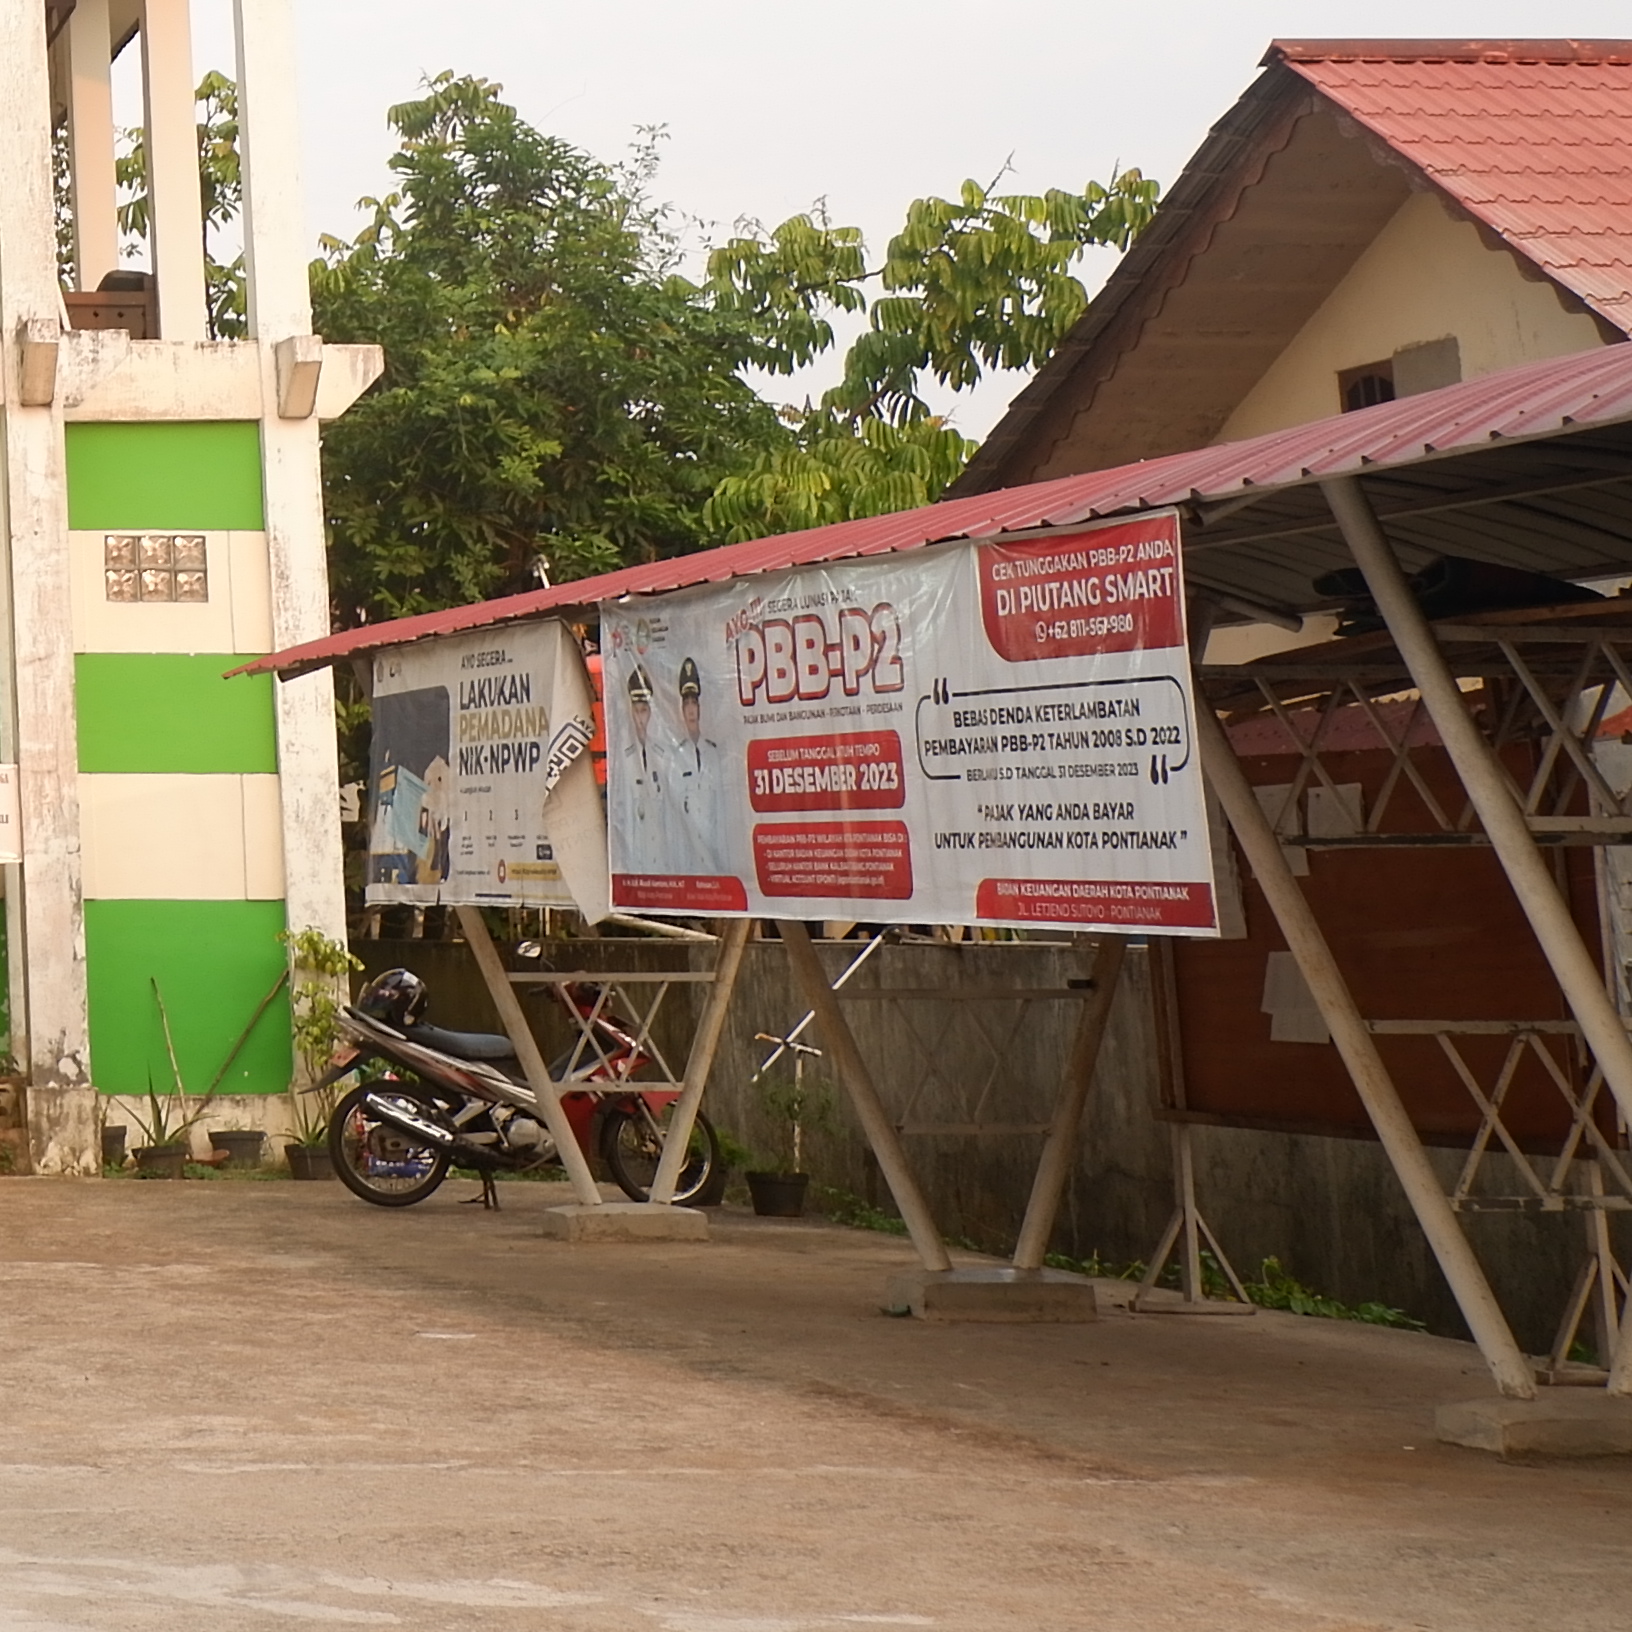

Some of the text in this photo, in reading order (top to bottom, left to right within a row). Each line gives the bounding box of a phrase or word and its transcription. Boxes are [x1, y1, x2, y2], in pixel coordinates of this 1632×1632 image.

[992, 539, 1174, 581] CEK TUNGGAKAN PBB-P2 ANDA
[997, 567, 1174, 616] DI PIUTANG SMART
[767, 598, 798, 615] SEGERA
[1048, 622, 1068, 640] +62
[461, 654, 475, 670] AYO
[736, 601, 905, 707] PBB-P2
[459, 672, 531, 710] LAKUKAN
[953, 698, 1141, 728] BEBAS DENDA KETERLAMBATAN
[855, 743, 881, 757] TEMPO
[924, 726, 1181, 757] PEMBAYARAN PBB-P2 TAHUN 2008 S.D 2022
[754, 762, 899, 796] 31 DESEMBER 2023
[1016, 765, 1057, 780] TANGGAL
[1058, 764, 1067, 779] 31
[1068, 763, 1116, 779] DESEMBER
[1117, 762, 1139, 777] 2023
[1017, 804, 1053, 821] YANG
[1055, 803, 1090, 820] ANDA
[1093, 802, 1135, 820] BAYAR
[934, 832, 976, 849] UNTUK
[1066, 831, 1099, 849] KOTA
[1020, 882, 1072, 898] KEUANGAN
[1072, 884, 1109, 899] DAERAH
[1109, 884, 1134, 900] KOTA
[1134, 886, 1190, 901] PONTIANAK
[1110, 905, 1162, 920] PONTIANAK
